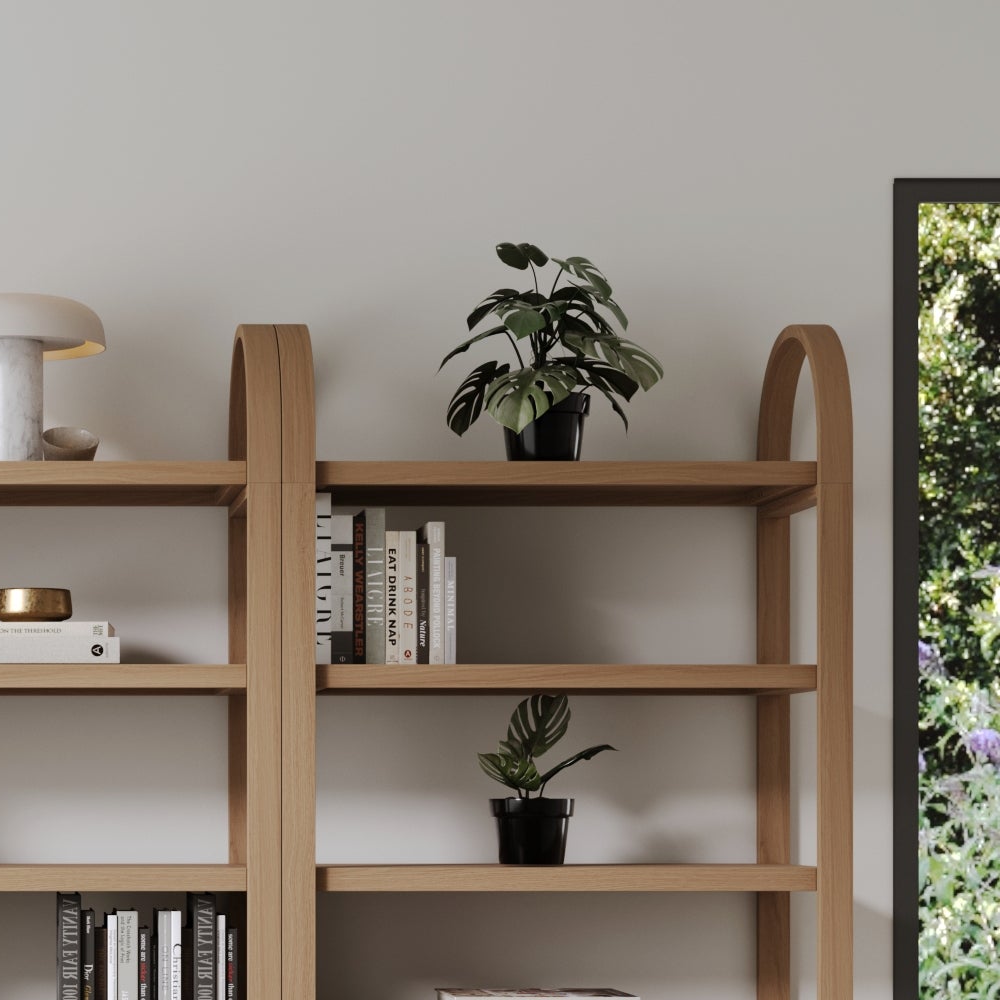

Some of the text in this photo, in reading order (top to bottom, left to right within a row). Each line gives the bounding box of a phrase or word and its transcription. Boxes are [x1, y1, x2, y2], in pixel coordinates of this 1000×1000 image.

[354, 523, 364, 656] KELLY WEARSTLER
[368, 547, 383, 626] LIAIGRE
[388, 548, 396, 646] EAT DRINK NAP
[404, 576, 413, 629] ABODE
[84, 964, 93, 980] Dior
